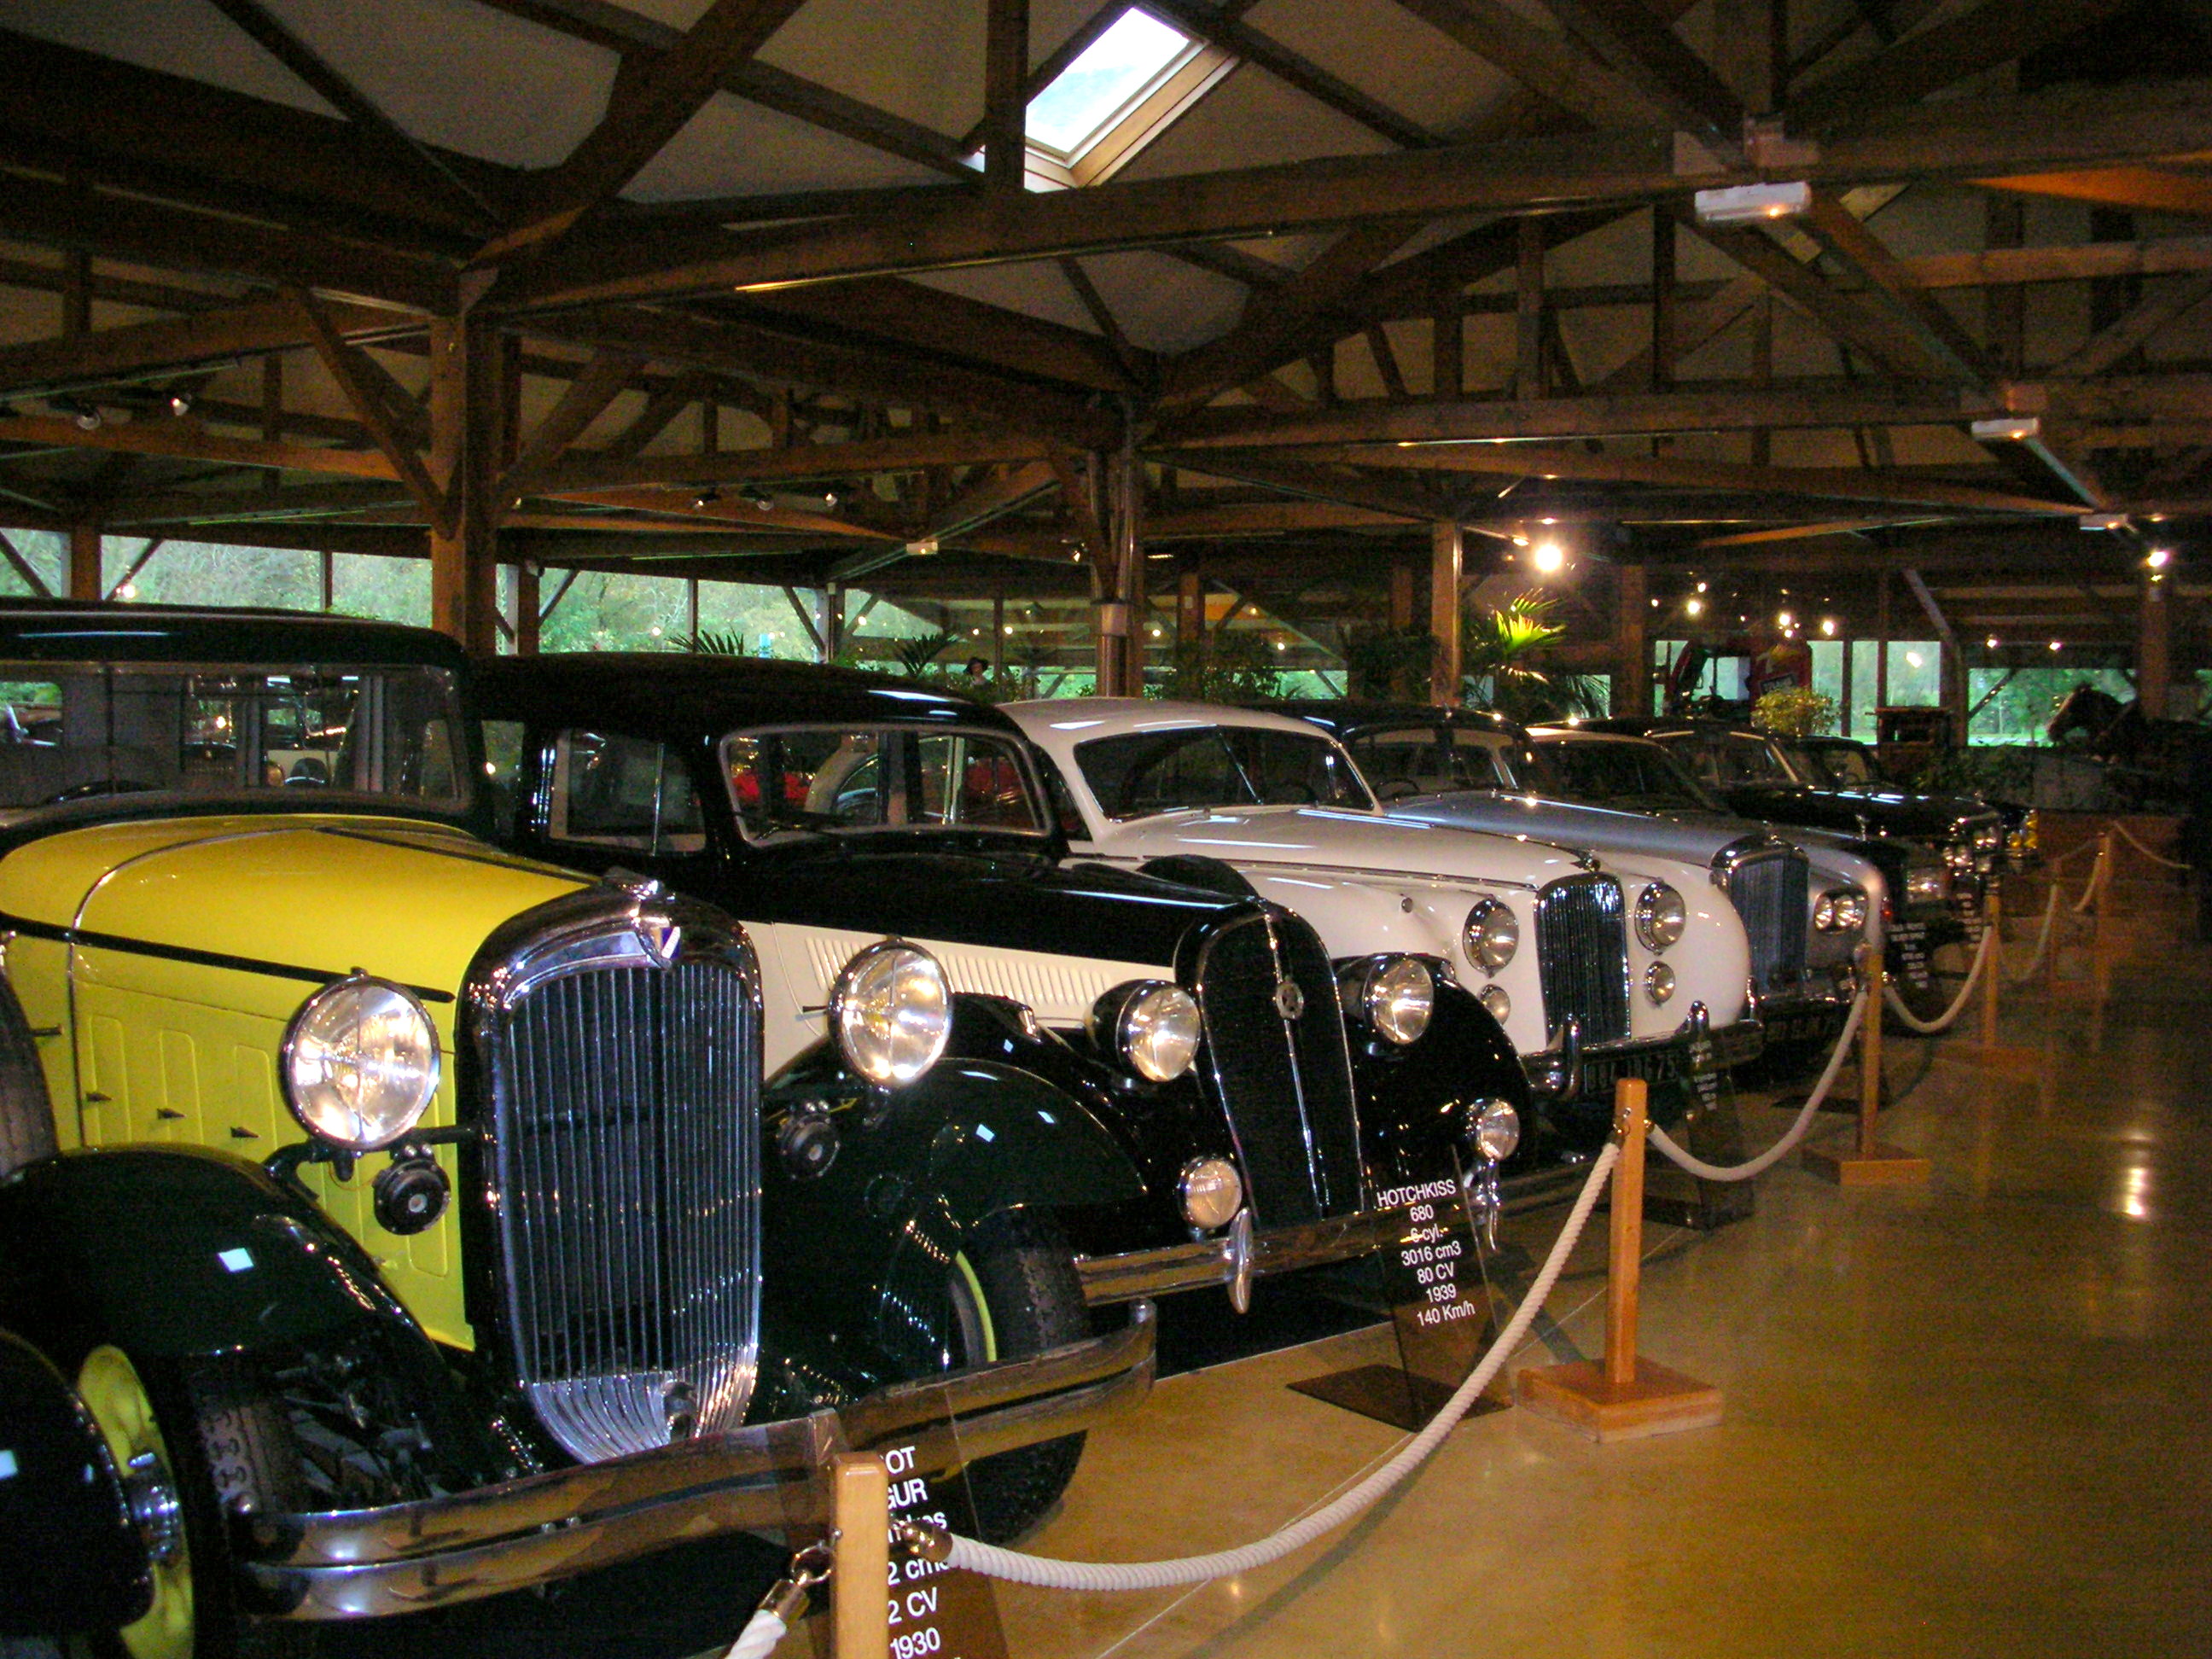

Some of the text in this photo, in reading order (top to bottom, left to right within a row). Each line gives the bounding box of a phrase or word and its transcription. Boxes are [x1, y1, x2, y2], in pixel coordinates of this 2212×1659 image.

[1377, 1179, 1456, 1208] HOTCHKISS
[1410, 1204, 1434, 1222] 680
[1400, 1240, 1462, 1266] 3016 cm3
[1417, 1261, 1455, 1284] 80 CV
[1425, 1283, 1457, 1303] 1939
[1417, 1300, 1476, 1326] 140 Km/h
[885, 1446, 916, 1475] OT
[906, 1586, 938, 1617] CV
[890, 1627, 941, 1659] 1930
